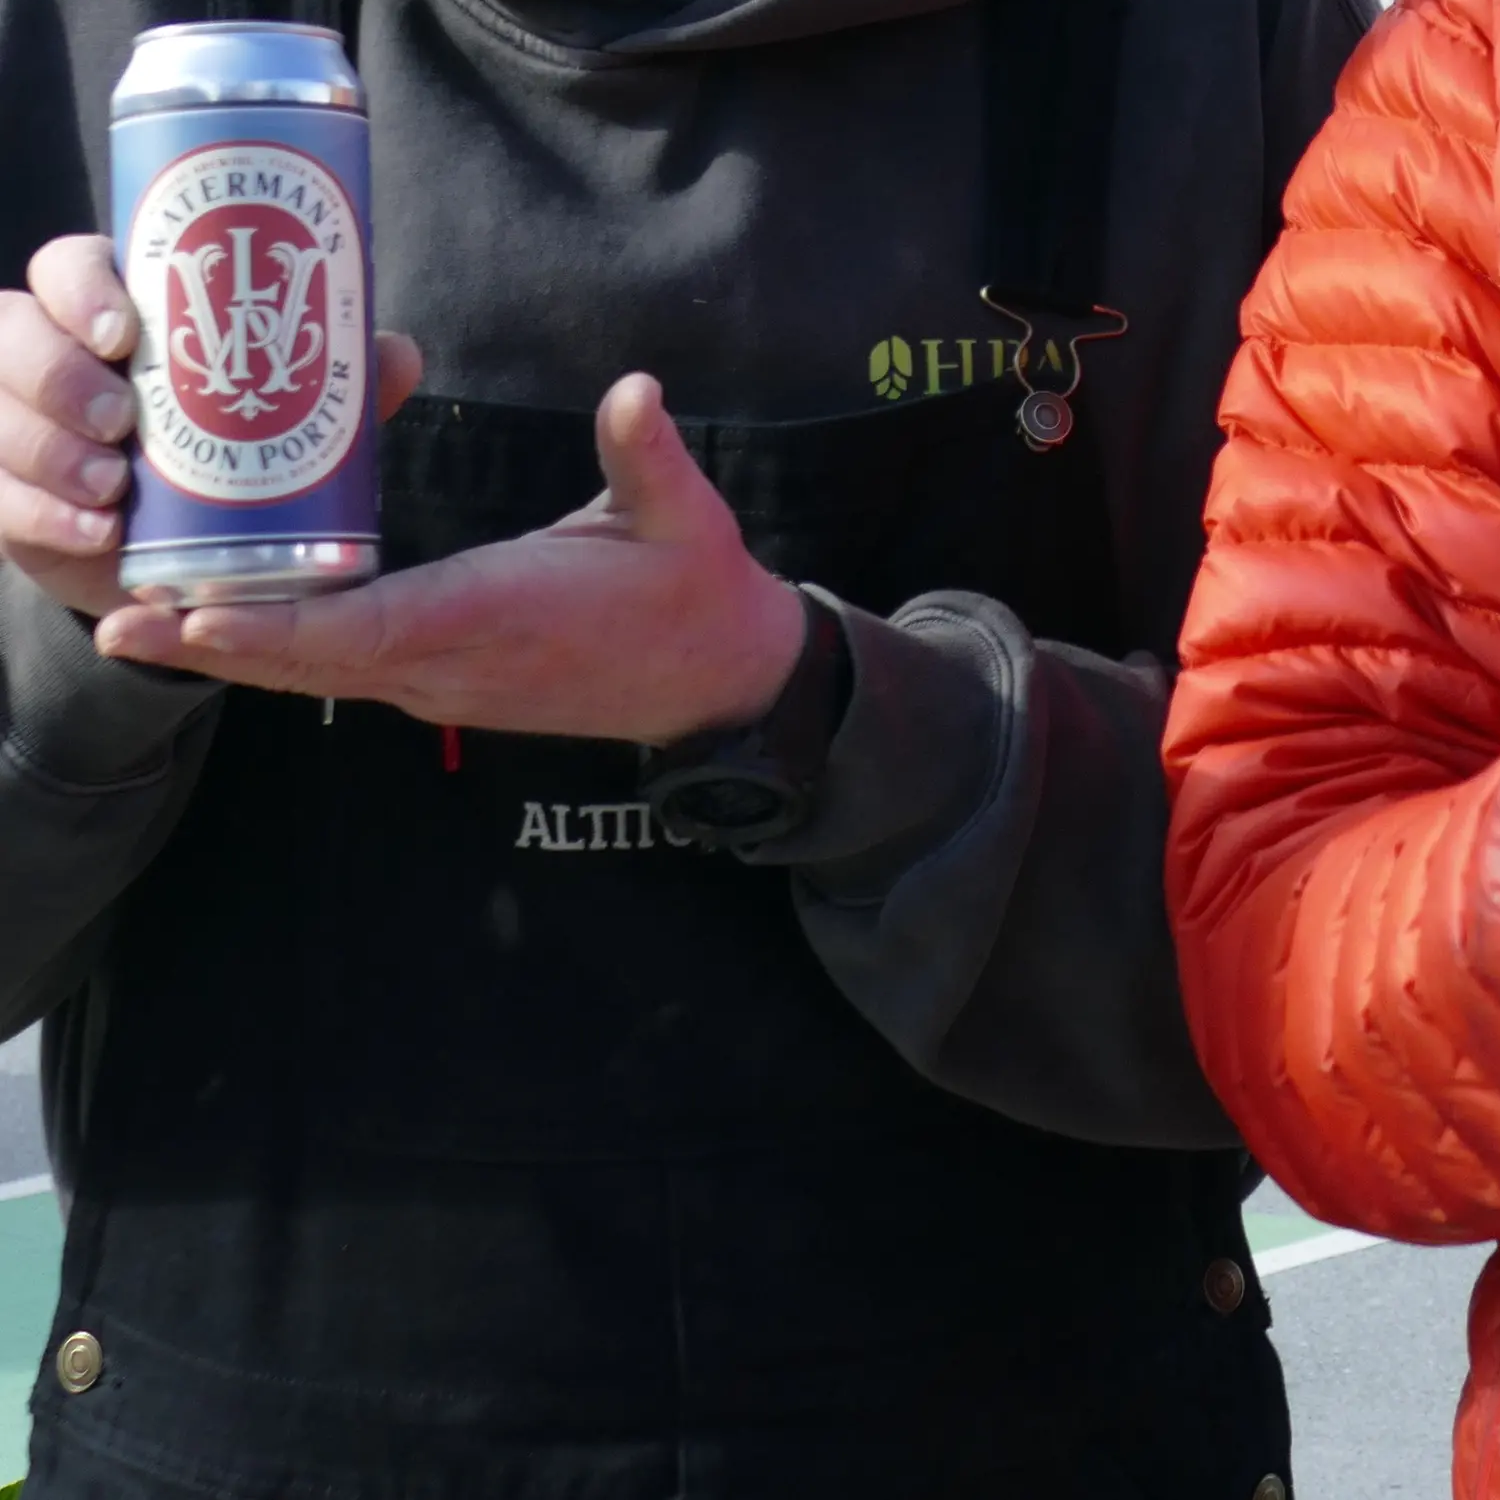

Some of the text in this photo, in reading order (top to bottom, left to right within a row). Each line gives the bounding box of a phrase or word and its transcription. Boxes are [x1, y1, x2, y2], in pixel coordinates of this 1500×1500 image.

[144, 171, 346, 260] WATERMAN'S
[257, 359, 351, 471] PORTER
[514, 801, 692, 851] ALTIT
